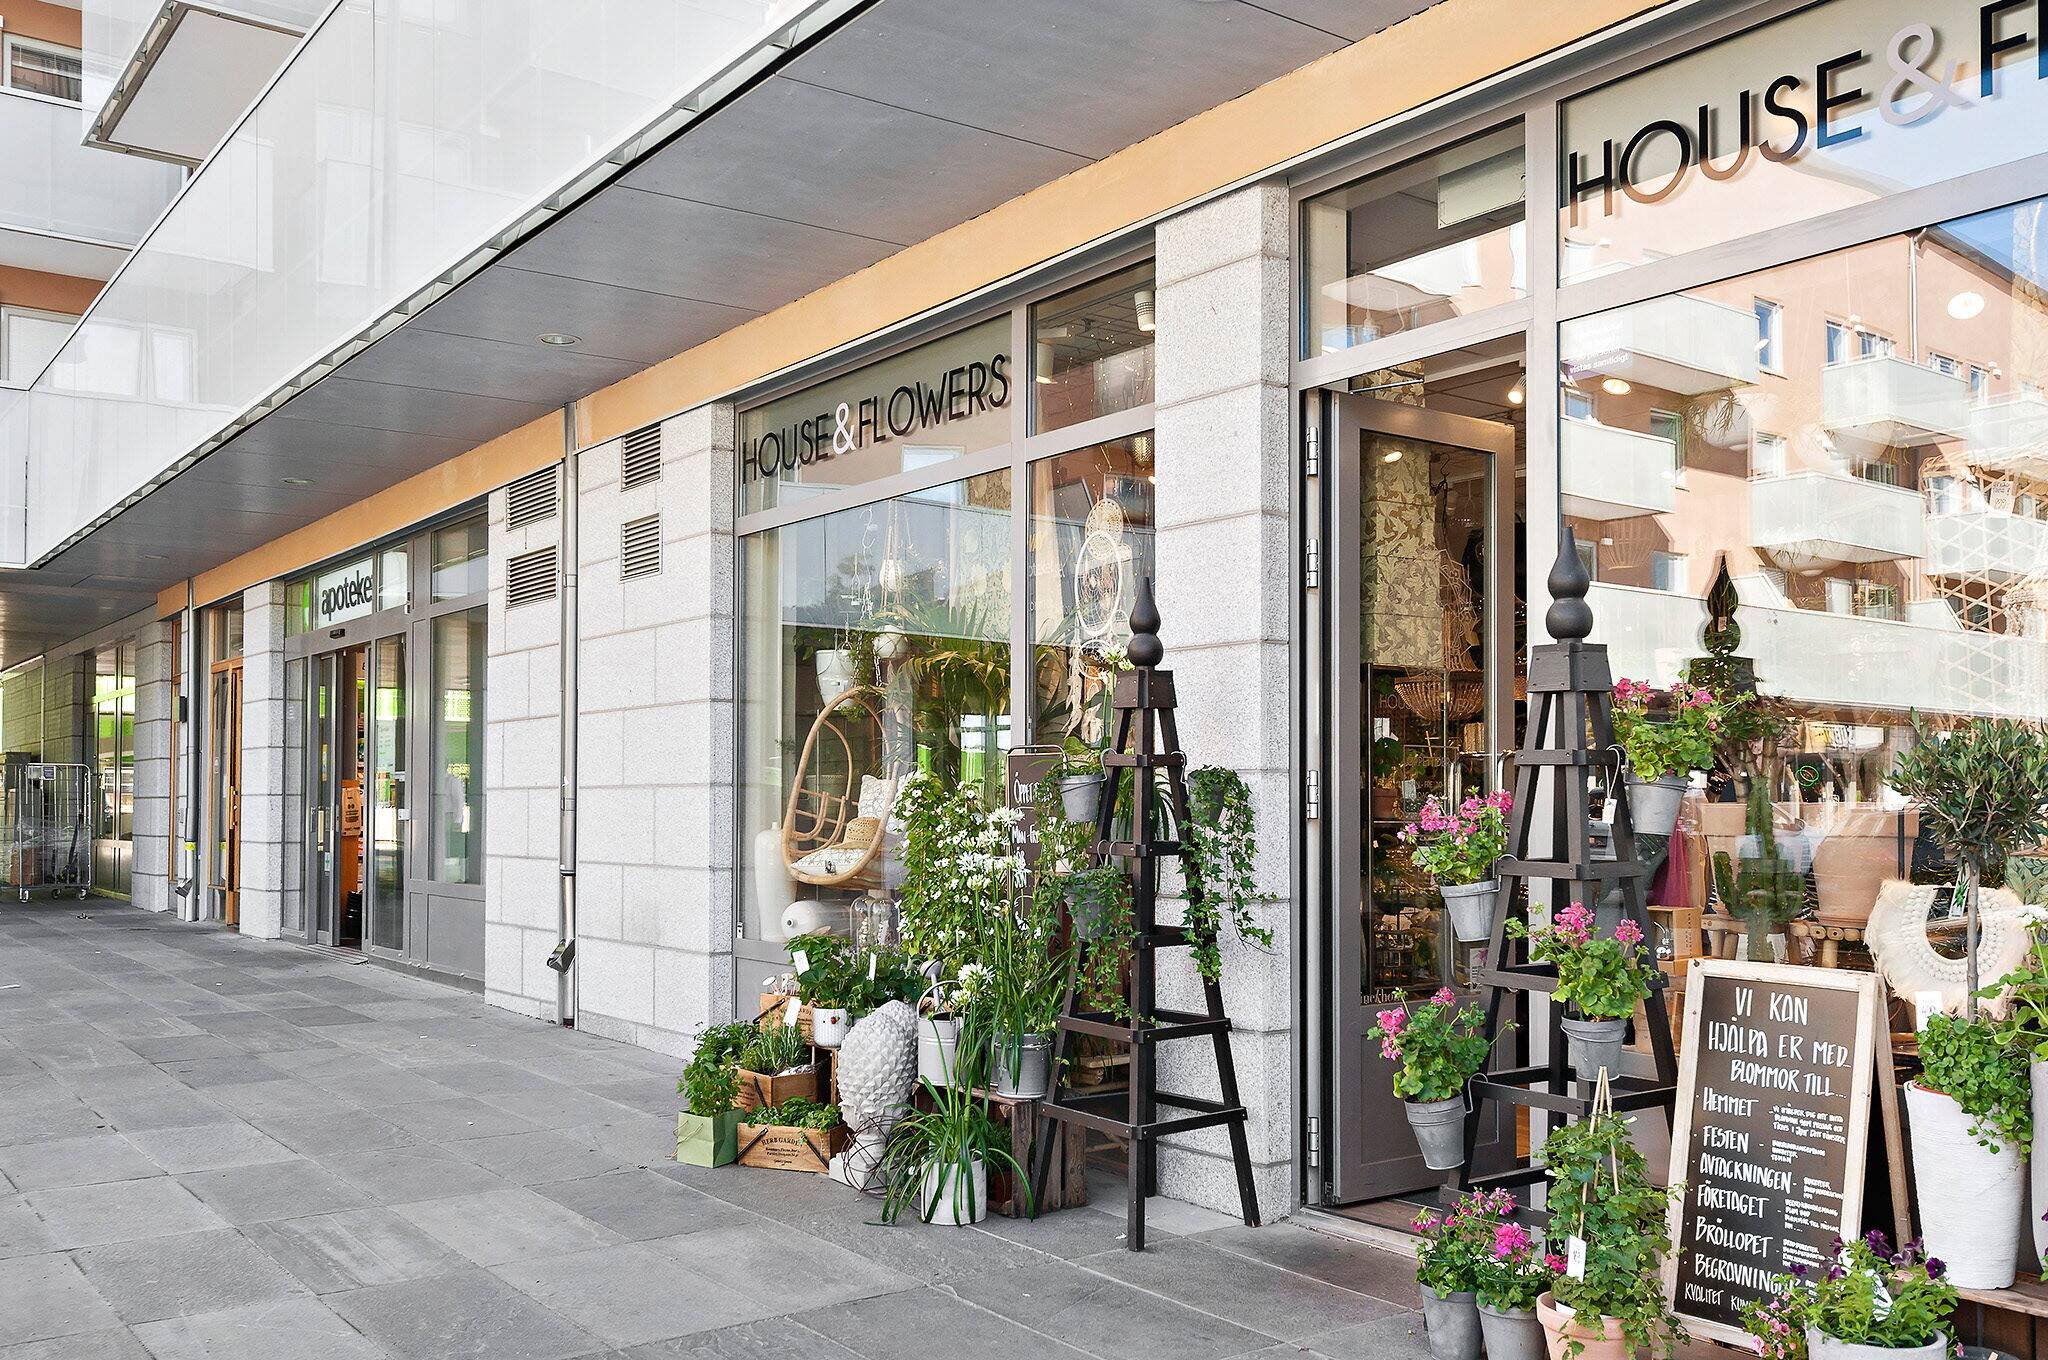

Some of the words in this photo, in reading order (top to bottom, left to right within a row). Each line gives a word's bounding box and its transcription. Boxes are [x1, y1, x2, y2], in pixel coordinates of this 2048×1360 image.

[1570, 49, 1863, 228] HOUSE
[322, 570, 373, 621] apoteke
[1735, 986, 1753, 1017] VI
[1769, 991, 1809, 1026] KAN
[1708, 1016, 1768, 1058] HJÄLPA
[1778, 1034, 1804, 1061] ER
[1730, 1059, 1800, 1093] BLOMMOR
[1703, 1087, 1759, 1117] HEMMET
[1702, 1125, 1749, 1154] FESTEN
[1700, 1152, 1792, 1194] AVTACKNINGEN
[1697, 1179, 1770, 1218] FÖRETAGET
[1696, 1216, 1773, 1258] BRÖLLOPET
[1684, 1282, 1724, 1306] KVALITET
[1694, 1253, 1794, 1296] BEGRAVNING
